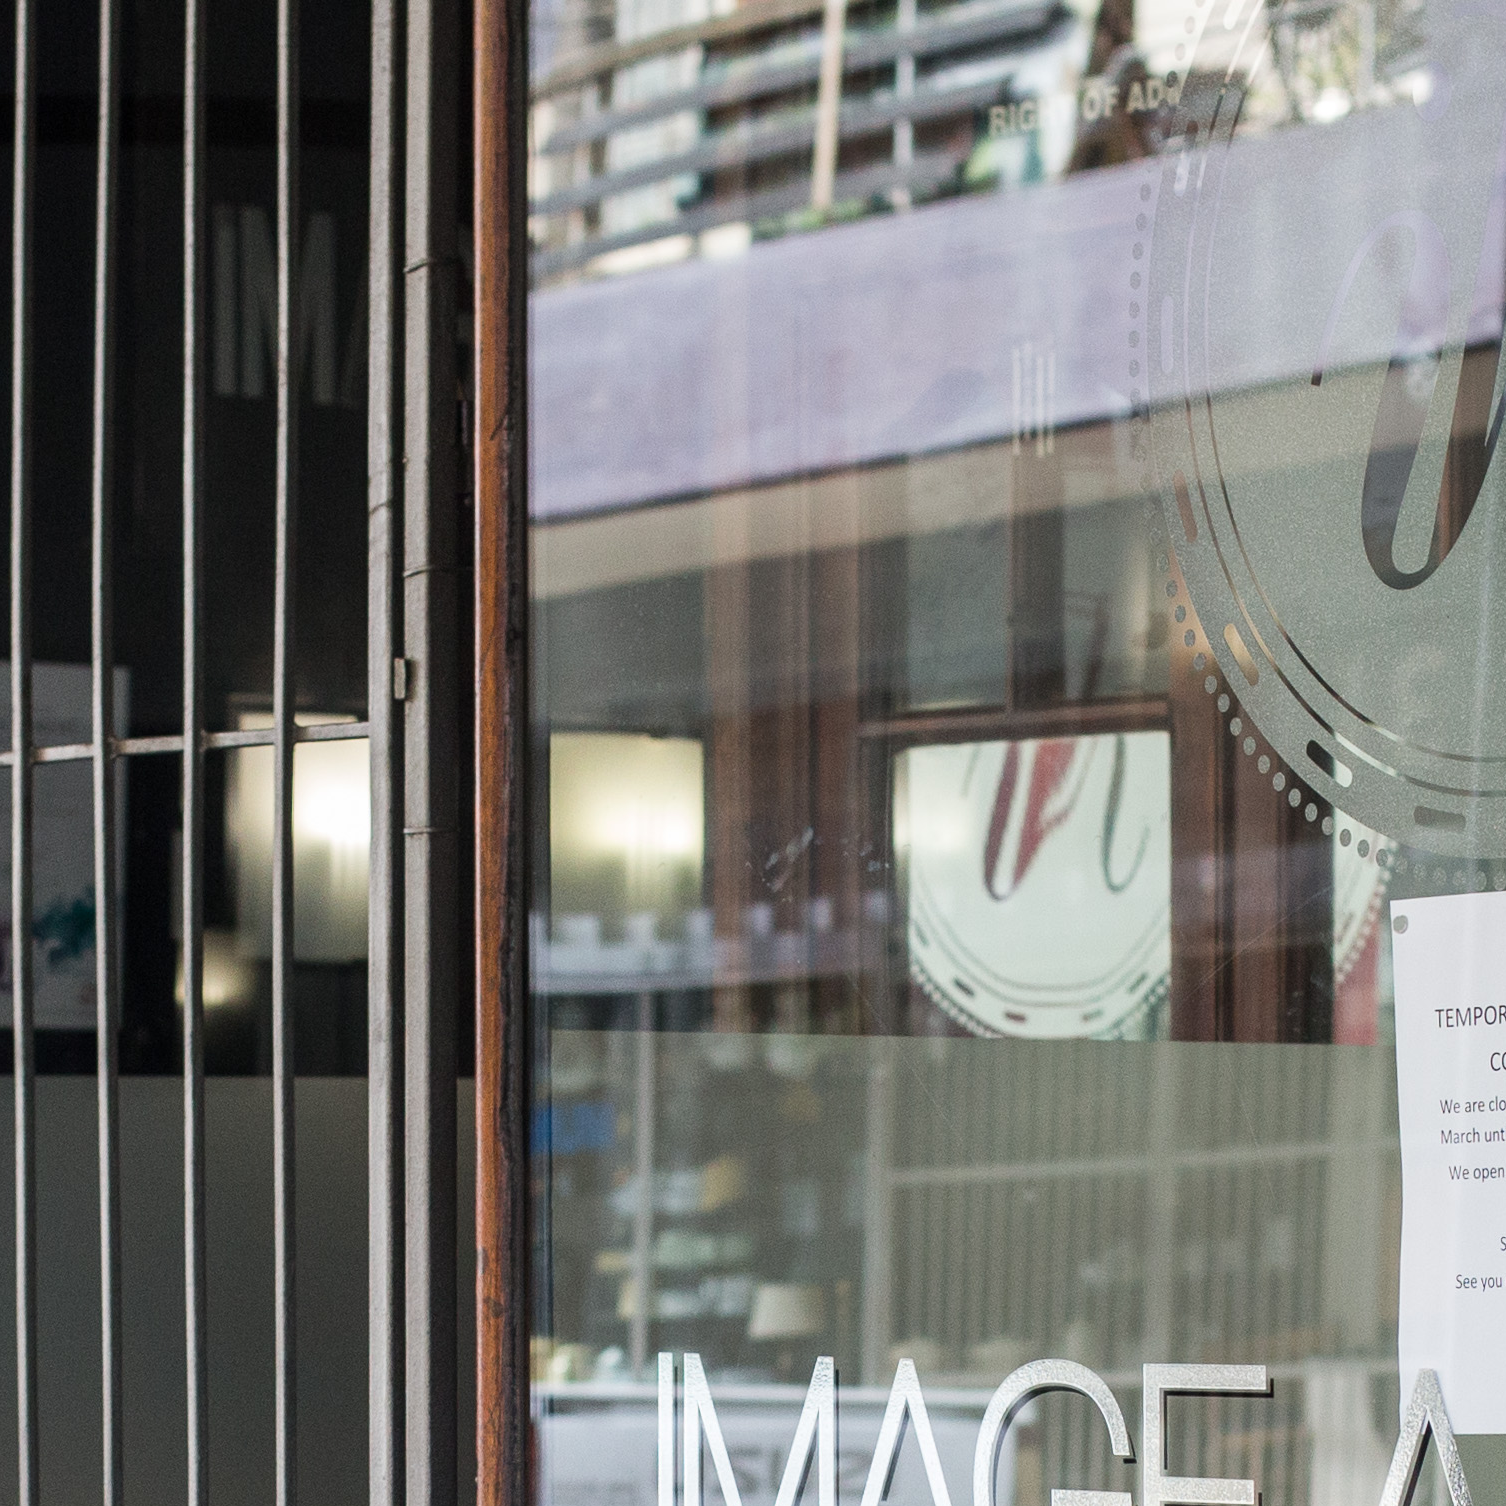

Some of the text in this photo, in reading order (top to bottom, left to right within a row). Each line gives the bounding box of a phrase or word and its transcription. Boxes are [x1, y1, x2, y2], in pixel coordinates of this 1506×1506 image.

[1081, 77, 1120, 121] OF
[1440, 1099, 1461, 1114] We
[1464, 1100, 1485, 1113] are
[1440, 1127, 1481, 1144] March
[1448, 1165, 1470, 1180] We
[1473, 1166, 1505, 1183] open
[1455, 1273, 1478, 1289] See
[1480, 1276, 1503, 1292] you
